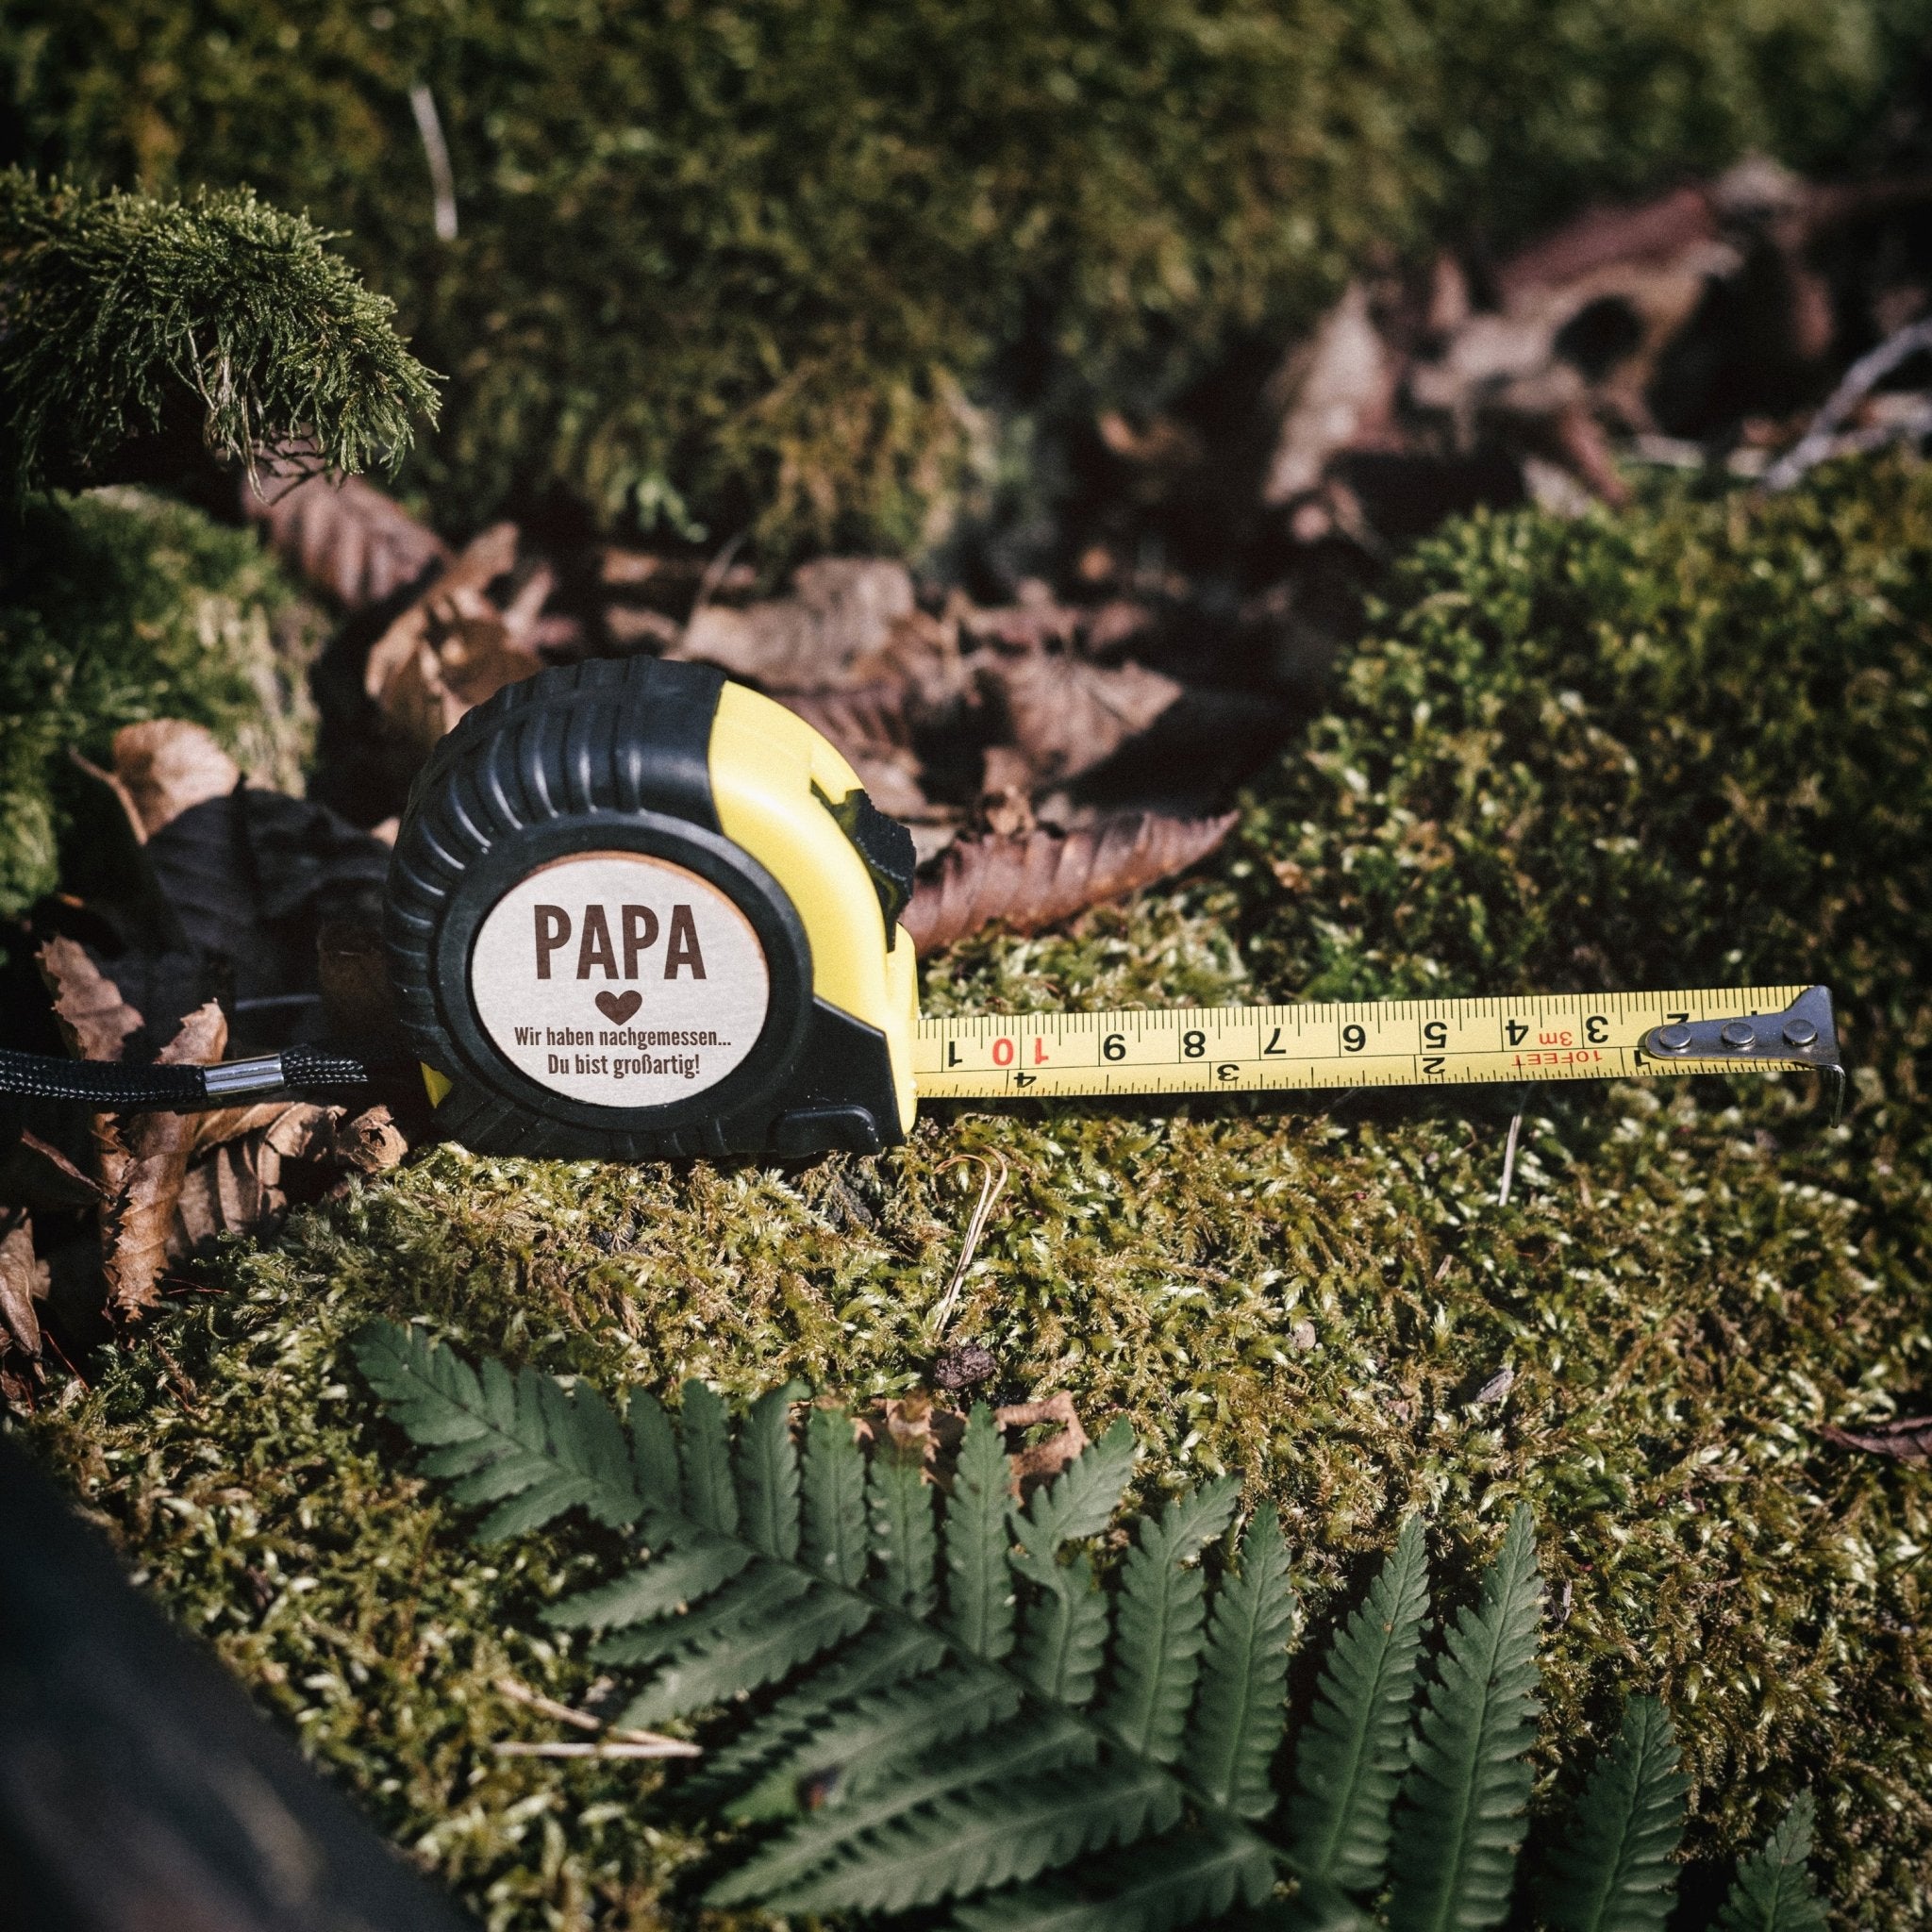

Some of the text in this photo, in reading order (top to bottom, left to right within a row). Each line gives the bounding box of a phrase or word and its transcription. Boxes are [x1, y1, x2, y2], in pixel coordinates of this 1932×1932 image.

[534, 904, 707, 980] PAPA
[514, 1026, 732, 1050] Wir haben nachgemessen...
[1264, 1027, 1287, 1055] 7
[1342, 1024, 1366, 1052] 6
[1424, 1021, 1448, 1049] 5
[1505, 1019, 1529, 1046] 4
[1539, 1030, 1573, 1046] 3m
[1586, 1015, 1609, 1043] 3
[1103, 1033, 1126, 1060] 9
[1183, 1030, 1206, 1058] 8
[547, 1054, 701, 1078] Du bist großartig!
[1217, 1063, 1240, 1082] 3
[1423, 1057, 1445, 1074] 2
[1013, 1072, 1037, 1088] 4
